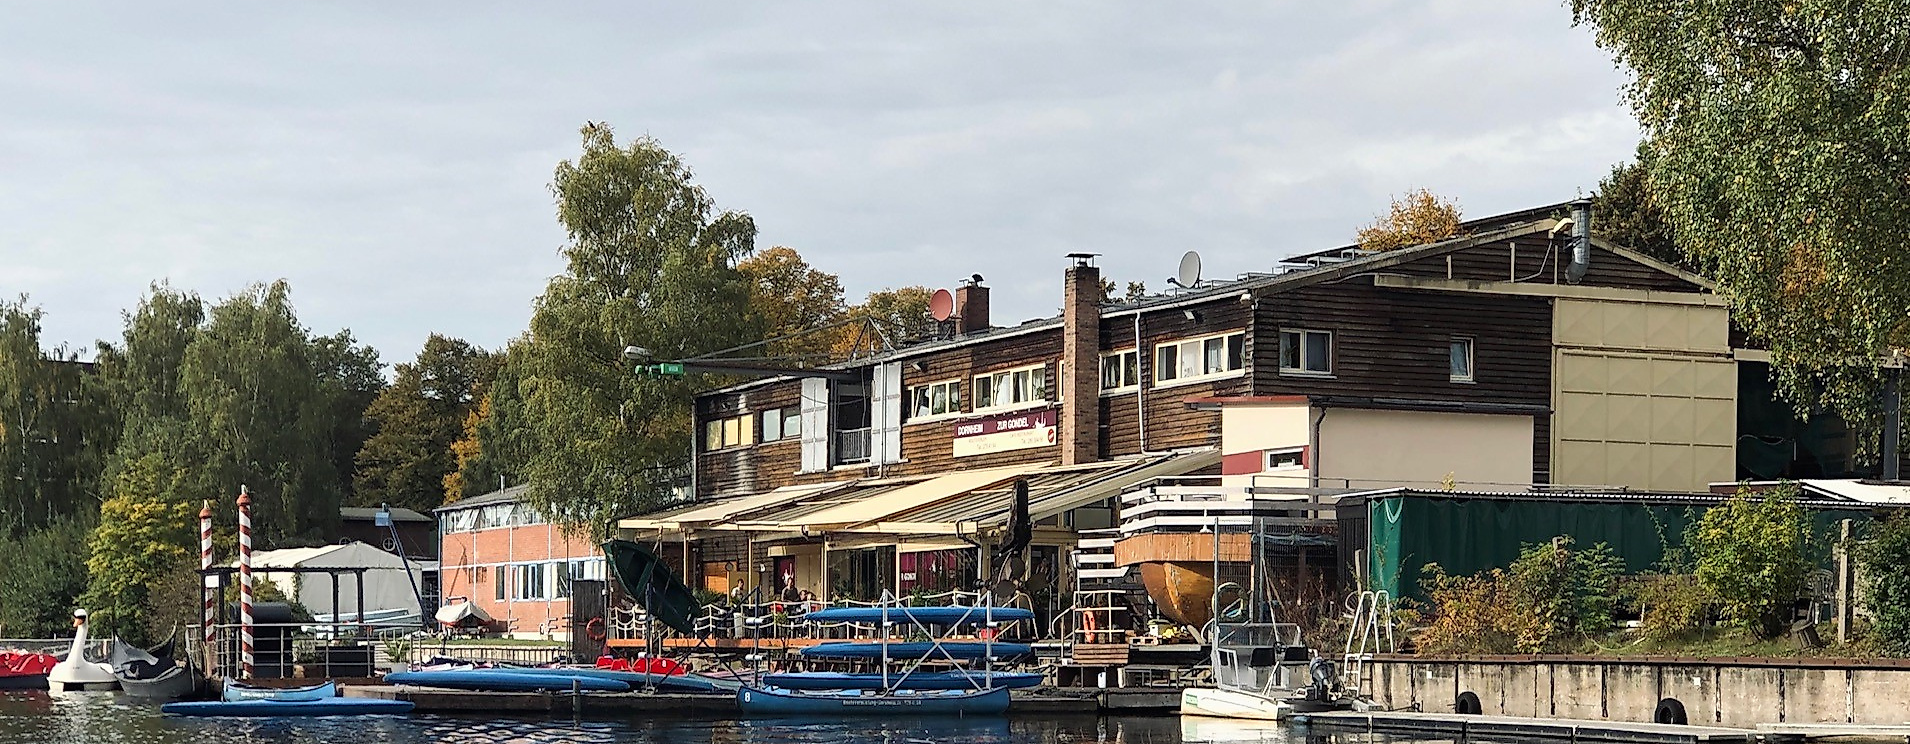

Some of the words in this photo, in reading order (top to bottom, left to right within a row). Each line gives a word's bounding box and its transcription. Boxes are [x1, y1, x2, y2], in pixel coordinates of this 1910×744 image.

[997, 420, 1007, 430] ZUR
[1008, 417, 1029, 429] GONDEL
[38, 655, 44, 663] 5
[744, 692, 751, 702] 8
